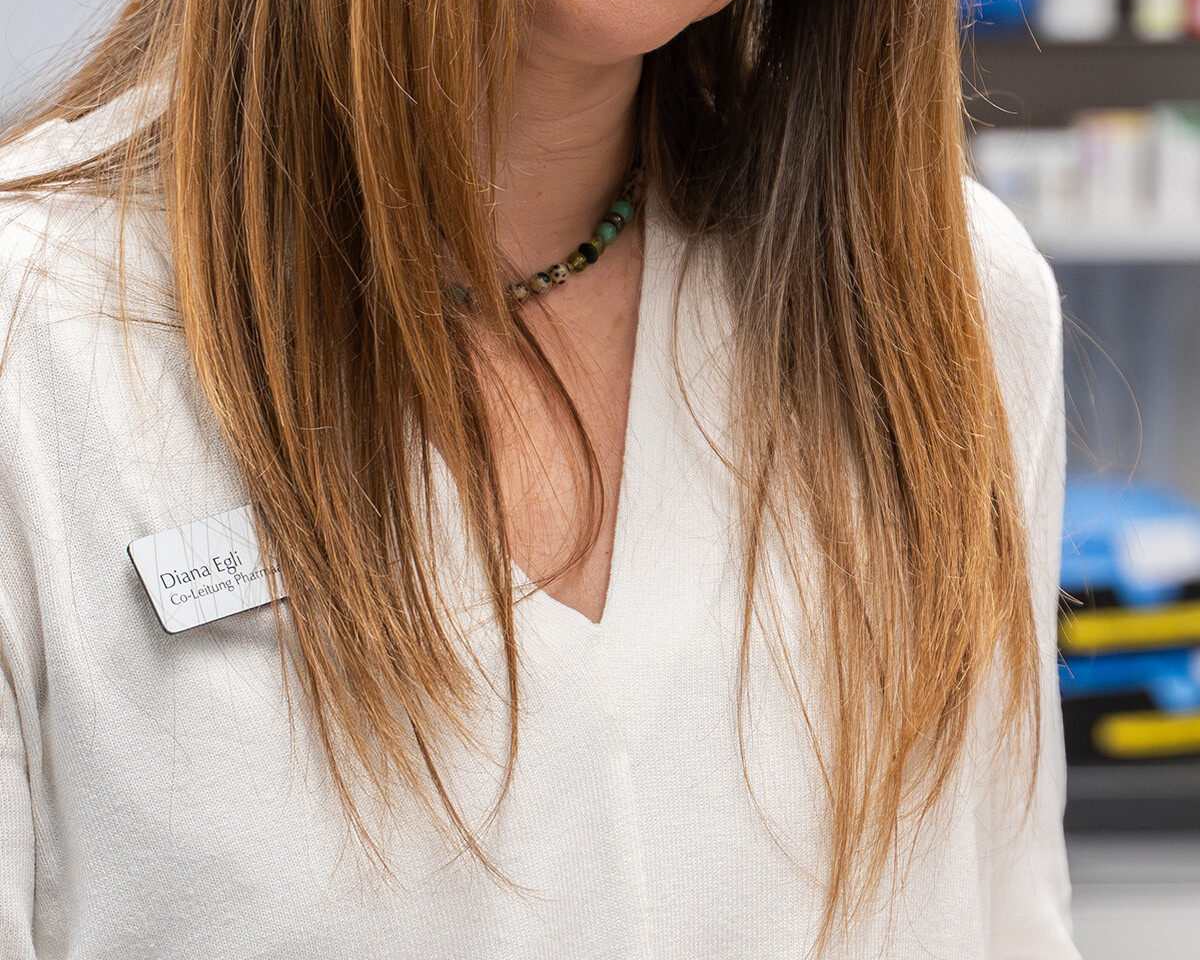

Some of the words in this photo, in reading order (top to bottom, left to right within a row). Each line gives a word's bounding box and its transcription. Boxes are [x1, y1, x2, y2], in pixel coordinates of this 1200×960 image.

[160, 565, 211, 589] Diana
[213, 551, 243, 575] Egli
[170, 579, 235, 606] Co-Leitung
